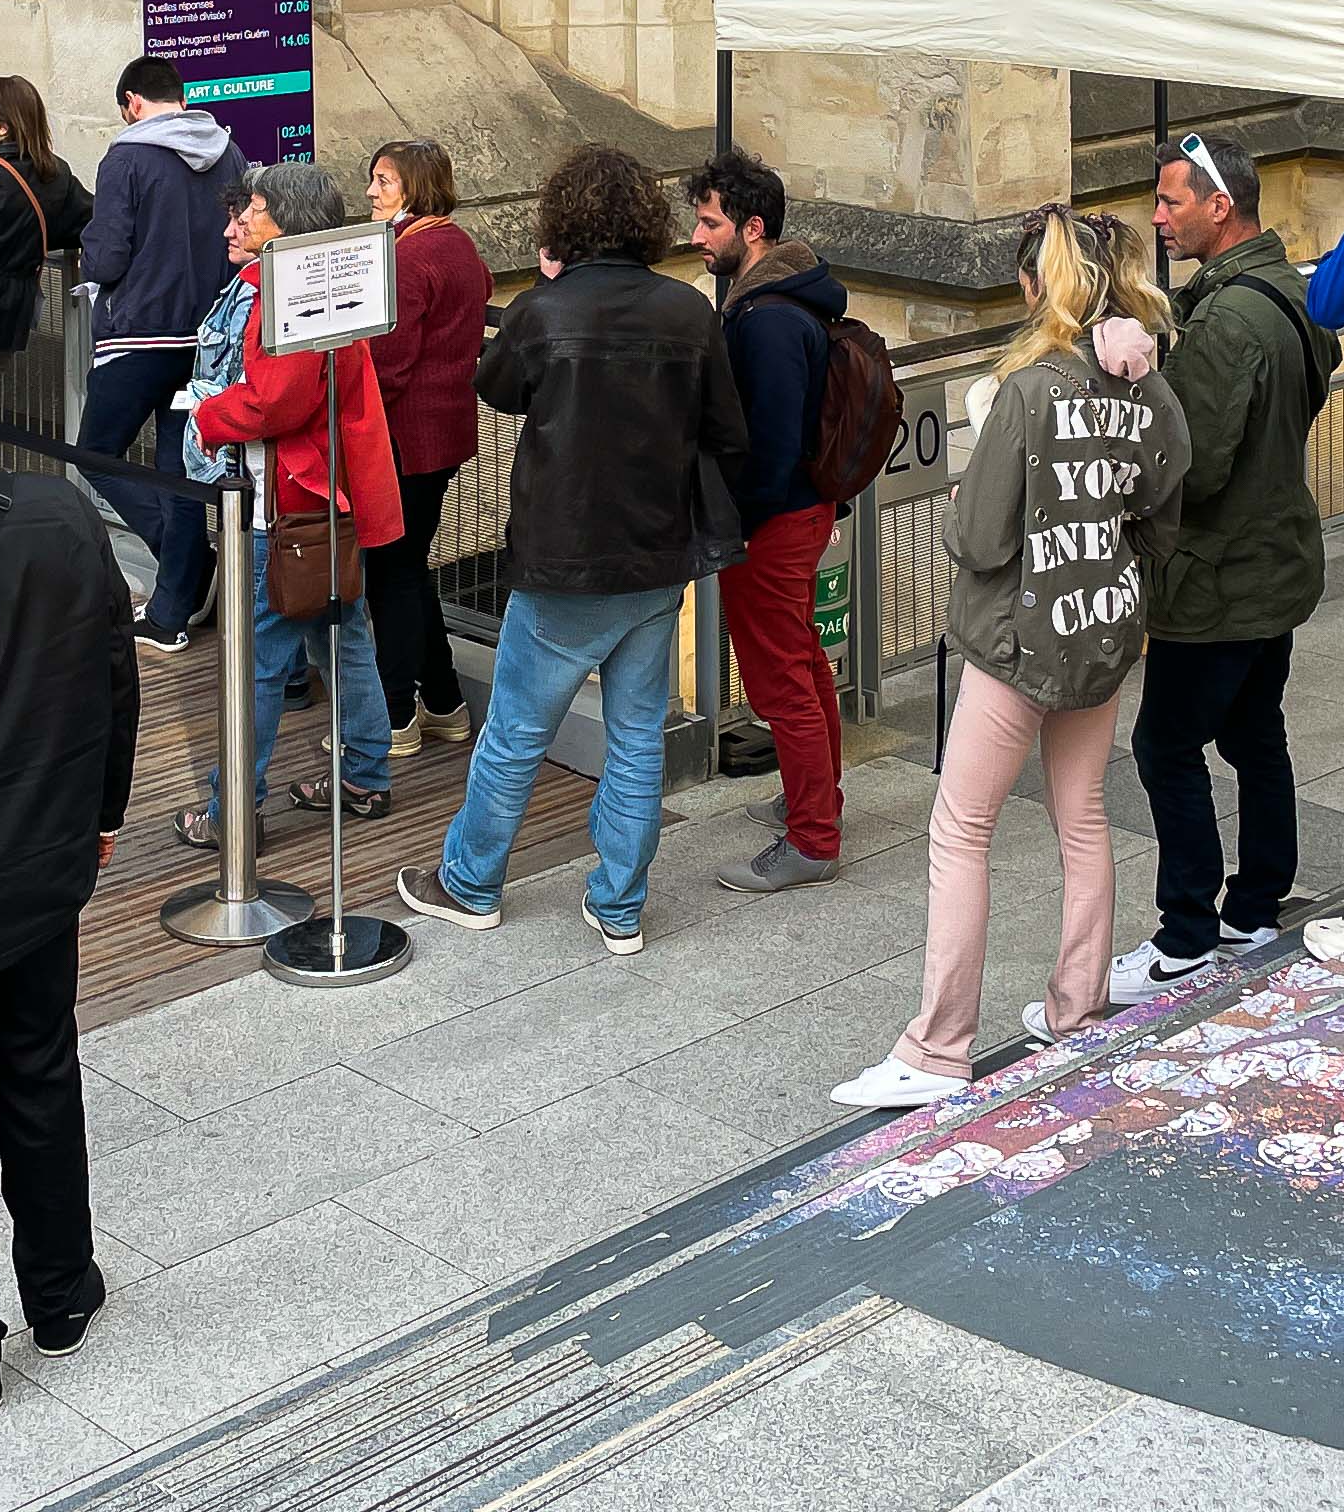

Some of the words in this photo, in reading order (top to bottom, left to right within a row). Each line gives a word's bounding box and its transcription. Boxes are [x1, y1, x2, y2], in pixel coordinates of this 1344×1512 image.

[280, 0, 309, 13] 07.06
[281, 34, 310, 47] 14.06
[188, 85, 210, 98] ART
[213, 84, 221, 96] &
[223, 79, 275, 94] CULTURE
[282, 124, 311, 138] 02.04
[283, 152, 311, 163] 1707
[1053, 398, 1153, 442] KEEP
[884, 410, 940, 475] 20
